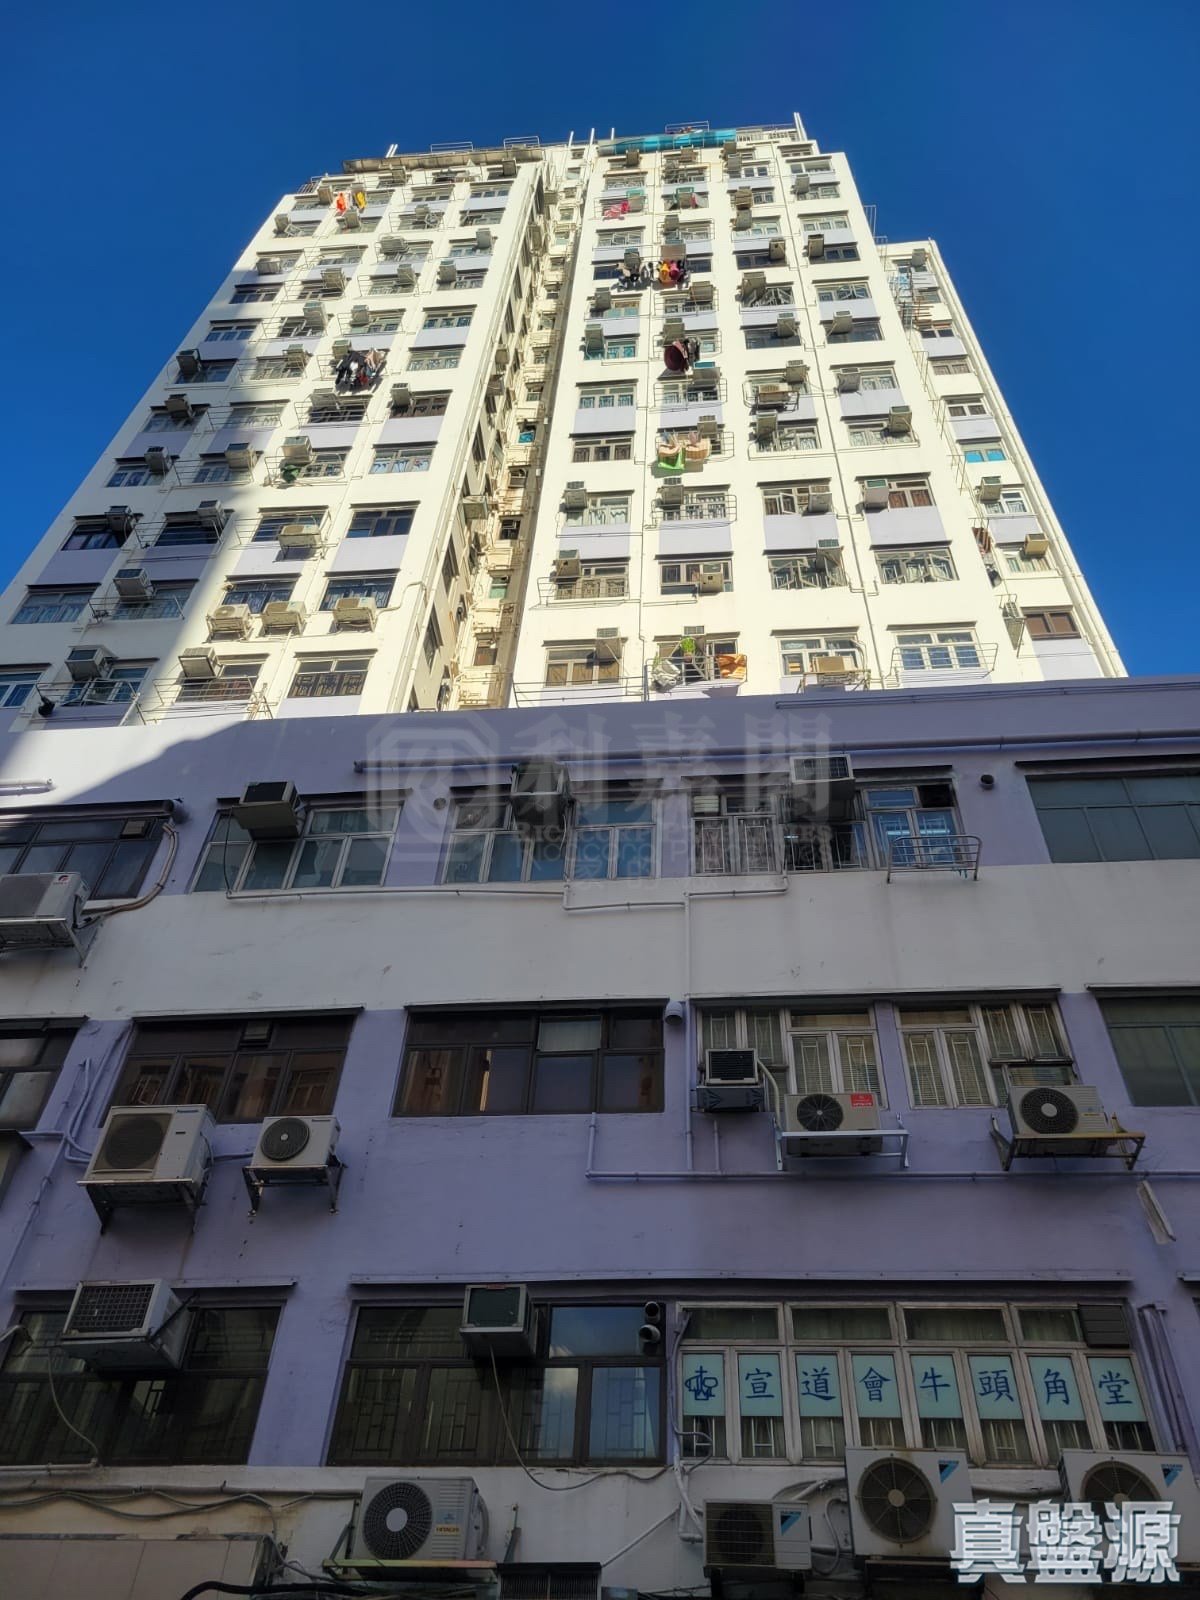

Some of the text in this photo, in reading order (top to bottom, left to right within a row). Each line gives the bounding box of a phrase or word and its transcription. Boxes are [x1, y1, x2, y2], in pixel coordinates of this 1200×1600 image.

[745, 1366, 1133, 1407] 宣道會牛頭角堂
